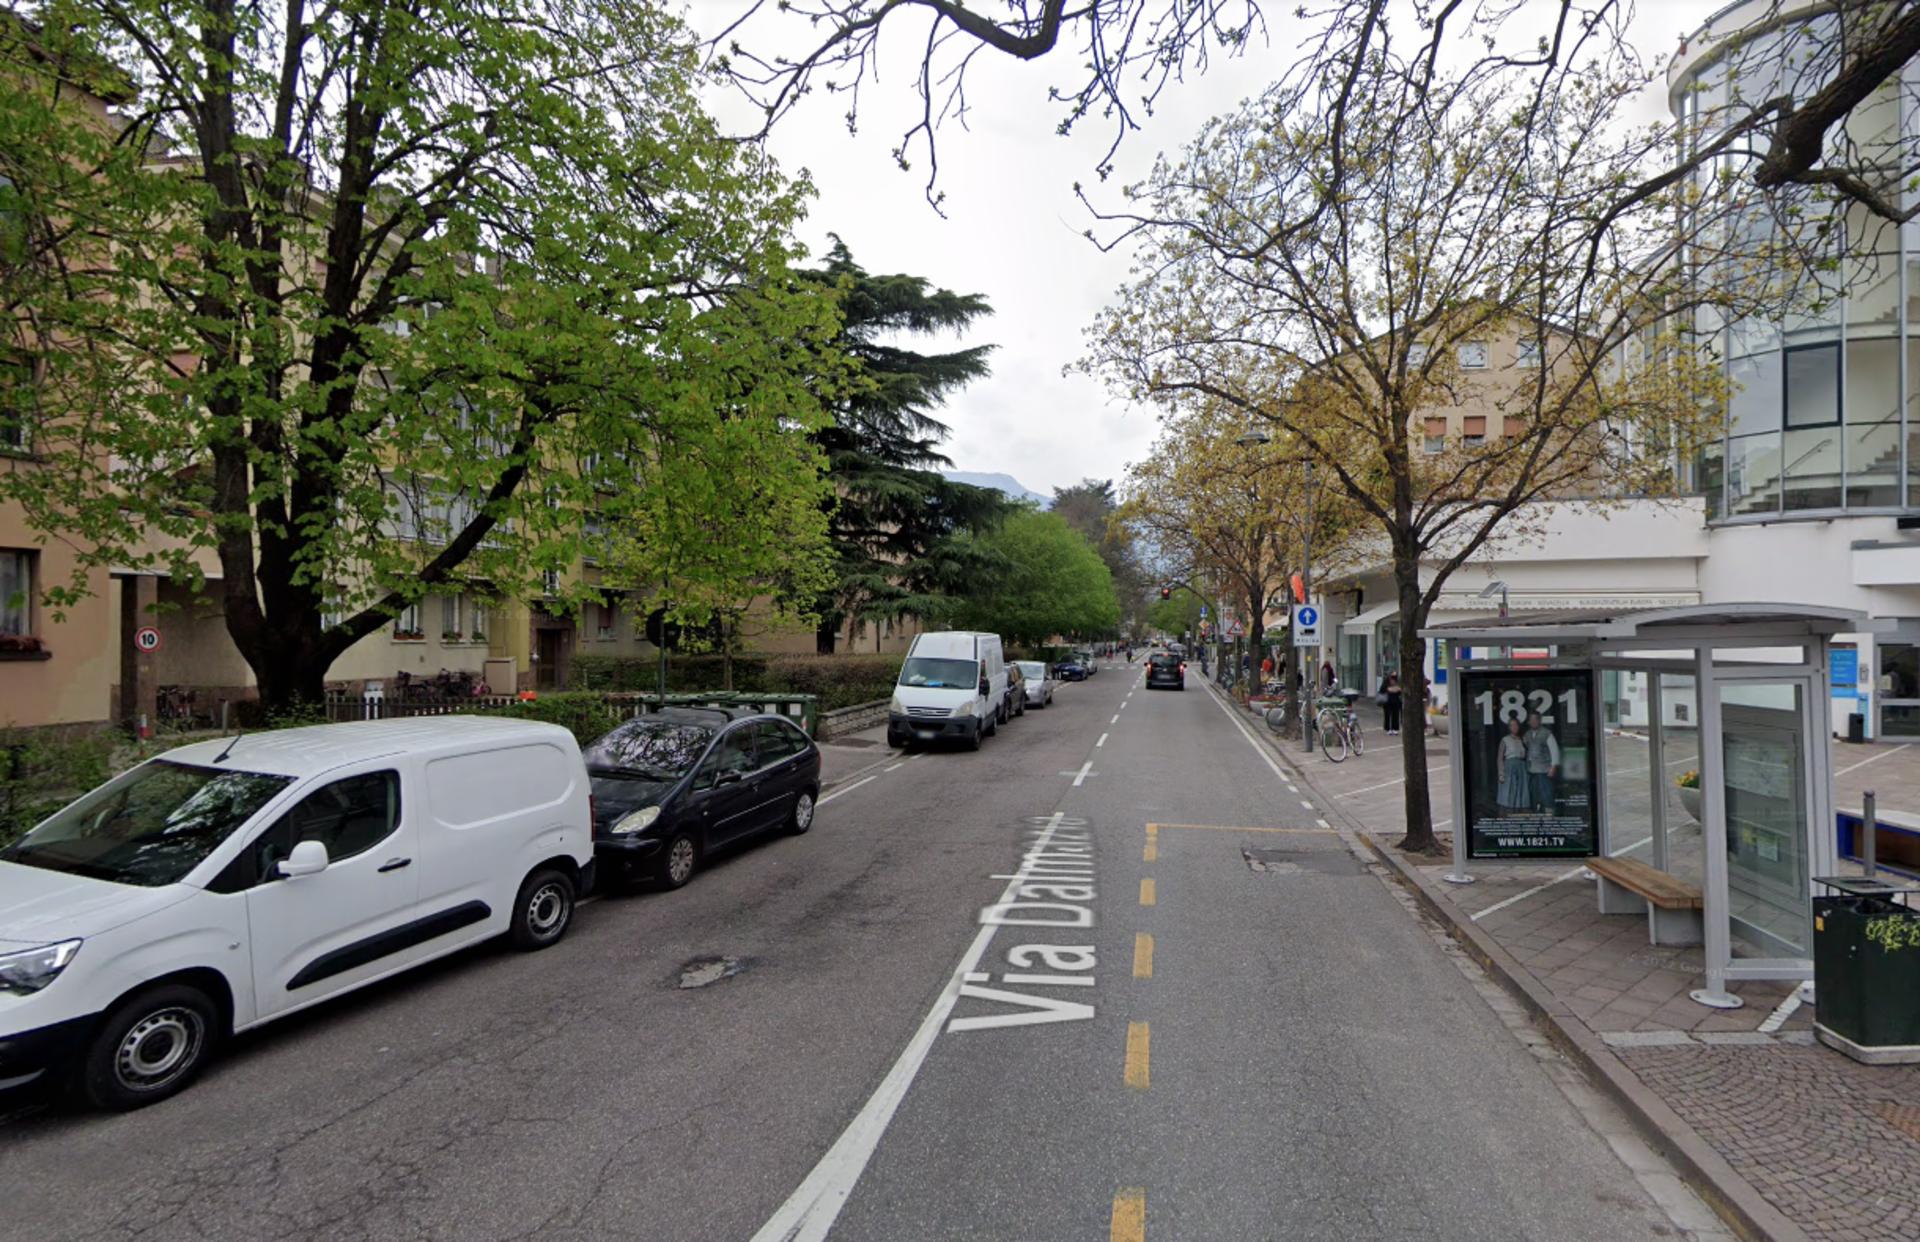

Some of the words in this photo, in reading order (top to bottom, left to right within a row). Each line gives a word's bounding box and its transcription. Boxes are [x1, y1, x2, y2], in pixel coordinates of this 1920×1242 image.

[142, 633, 155, 645] 10
[1474, 689, 1578, 725] 1821
[1497, 837, 1565, 846] WWW.1821.TV
[947, 944, 1096, 1033] Via
